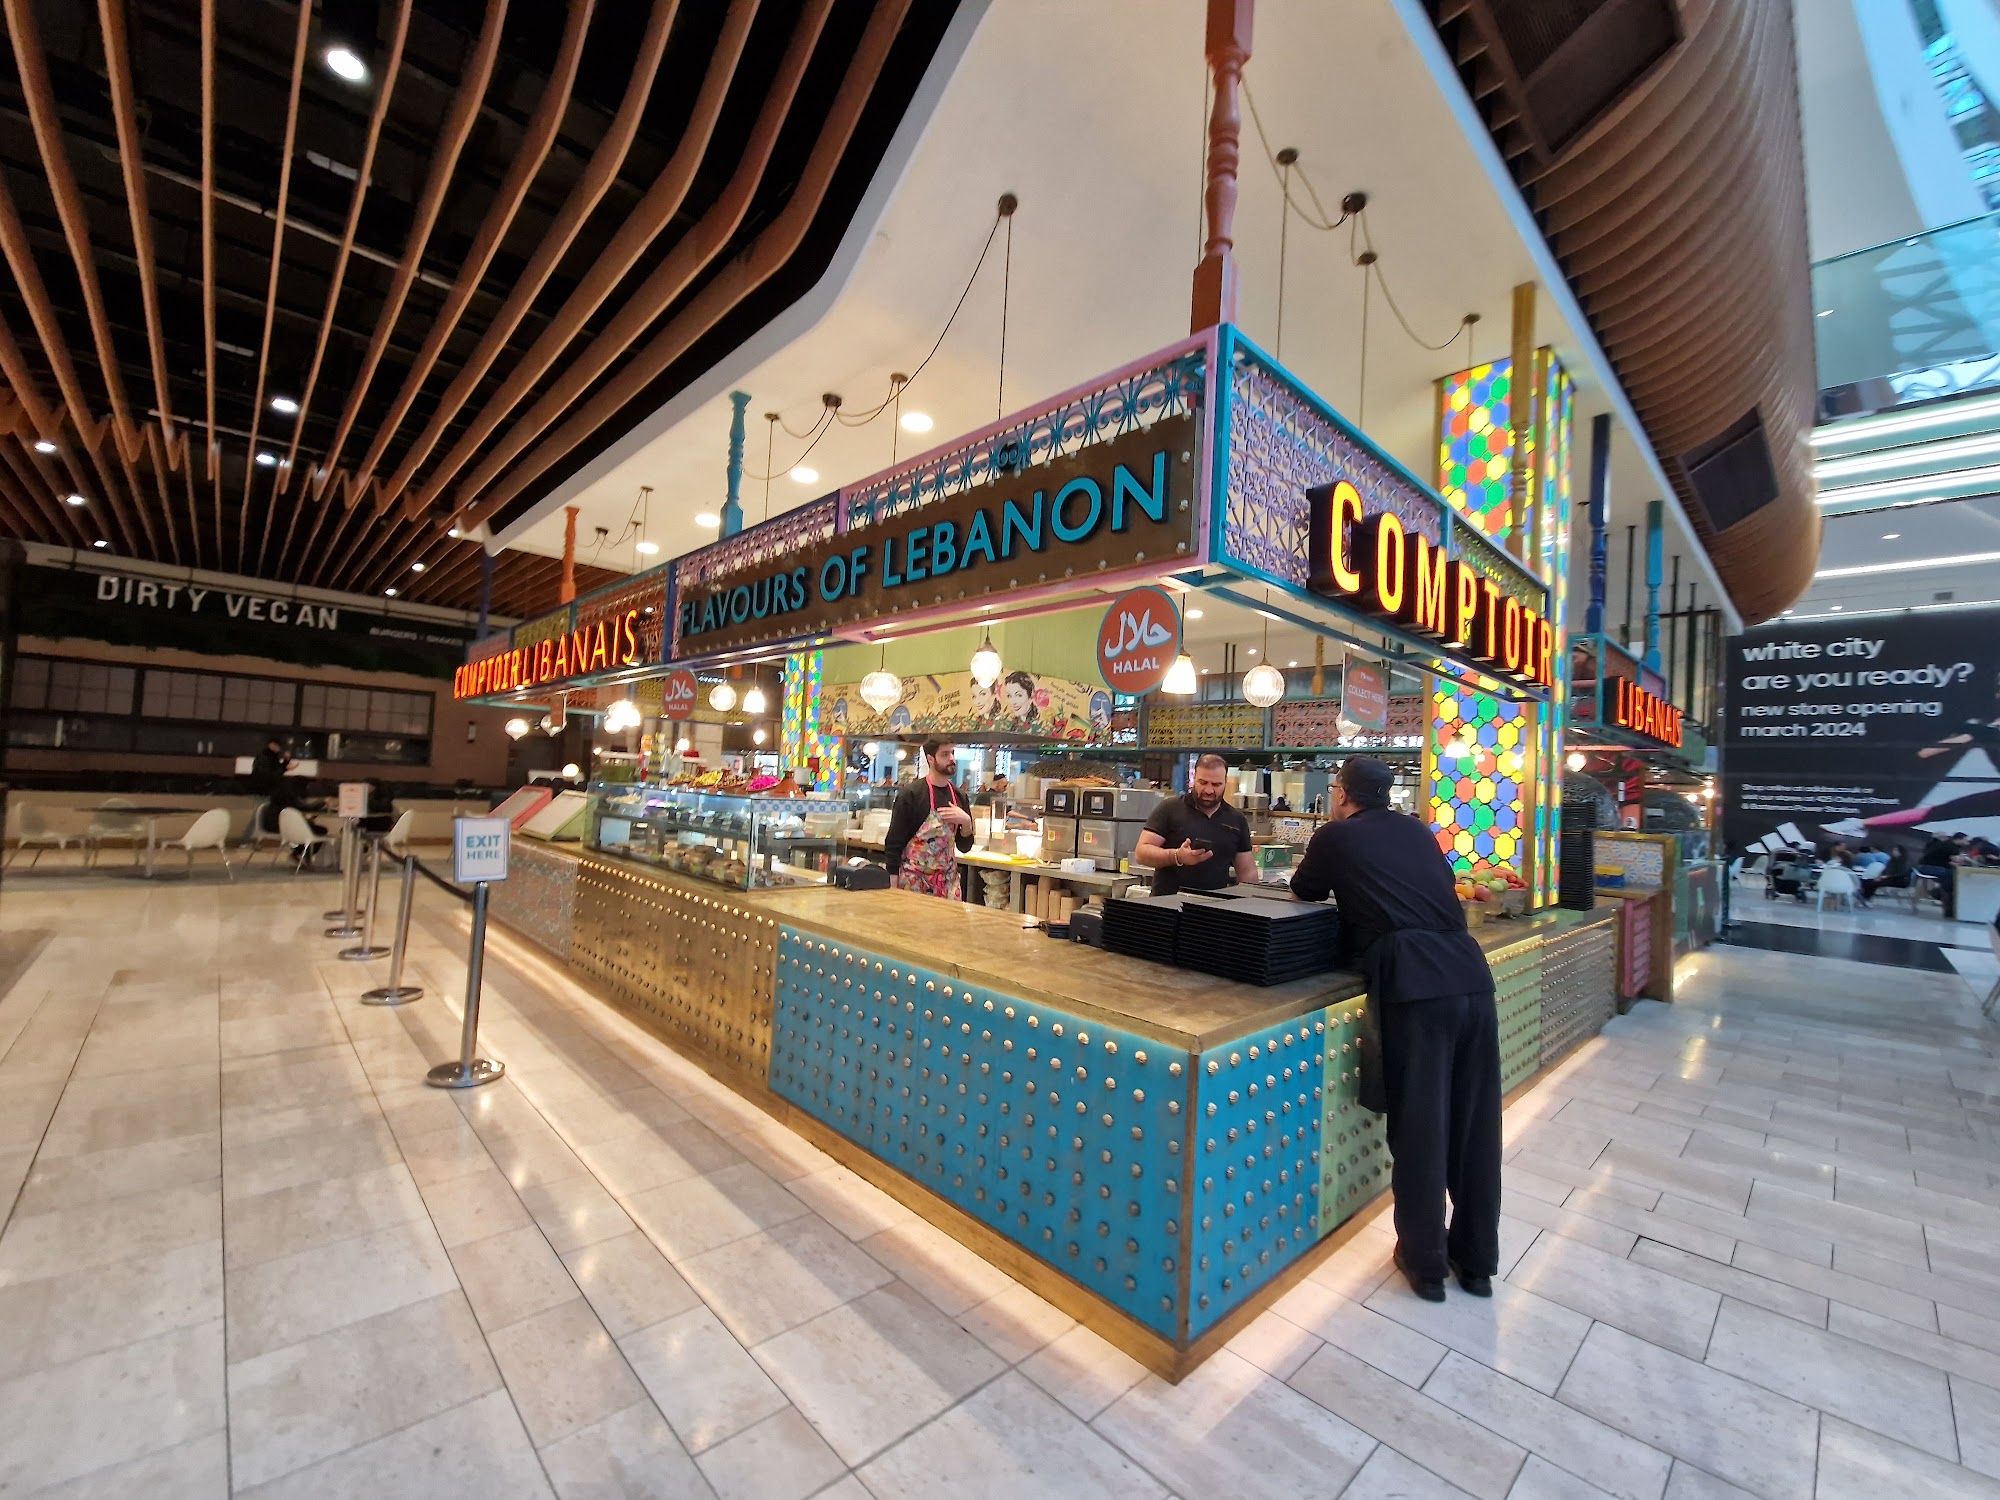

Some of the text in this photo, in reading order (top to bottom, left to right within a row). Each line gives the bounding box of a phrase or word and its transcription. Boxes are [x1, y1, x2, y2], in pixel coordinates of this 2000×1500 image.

[679, 450, 1168, 638] FLAVOURS OF LEBANON
[97, 575, 207, 613] DIRTY
[1330, 480, 1553, 688] COMPTOIR
[1104, 607, 1172, 660] حلال
[453, 609, 639, 699] COMPTOIR LIBANAIS
[1742, 637, 1886, 662] white city
[1112, 656, 1160, 676] HALAL
[1741, 662, 1976, 693] are you ready?
[665, 678, 694, 703] حلال
[1347, 684, 1371, 699] COLLECT
[668, 703, 689, 712] HALAL
[1617, 676, 1685, 749] LIBANAIS
[1740, 704, 1786, 717] new
[1787, 701, 1844, 716] store
[1845, 700, 1943, 718] opening
[1740, 722, 1867, 737] march 2024
[466, 835, 501, 848] EXIT
[466, 851, 499, 860] HERE
